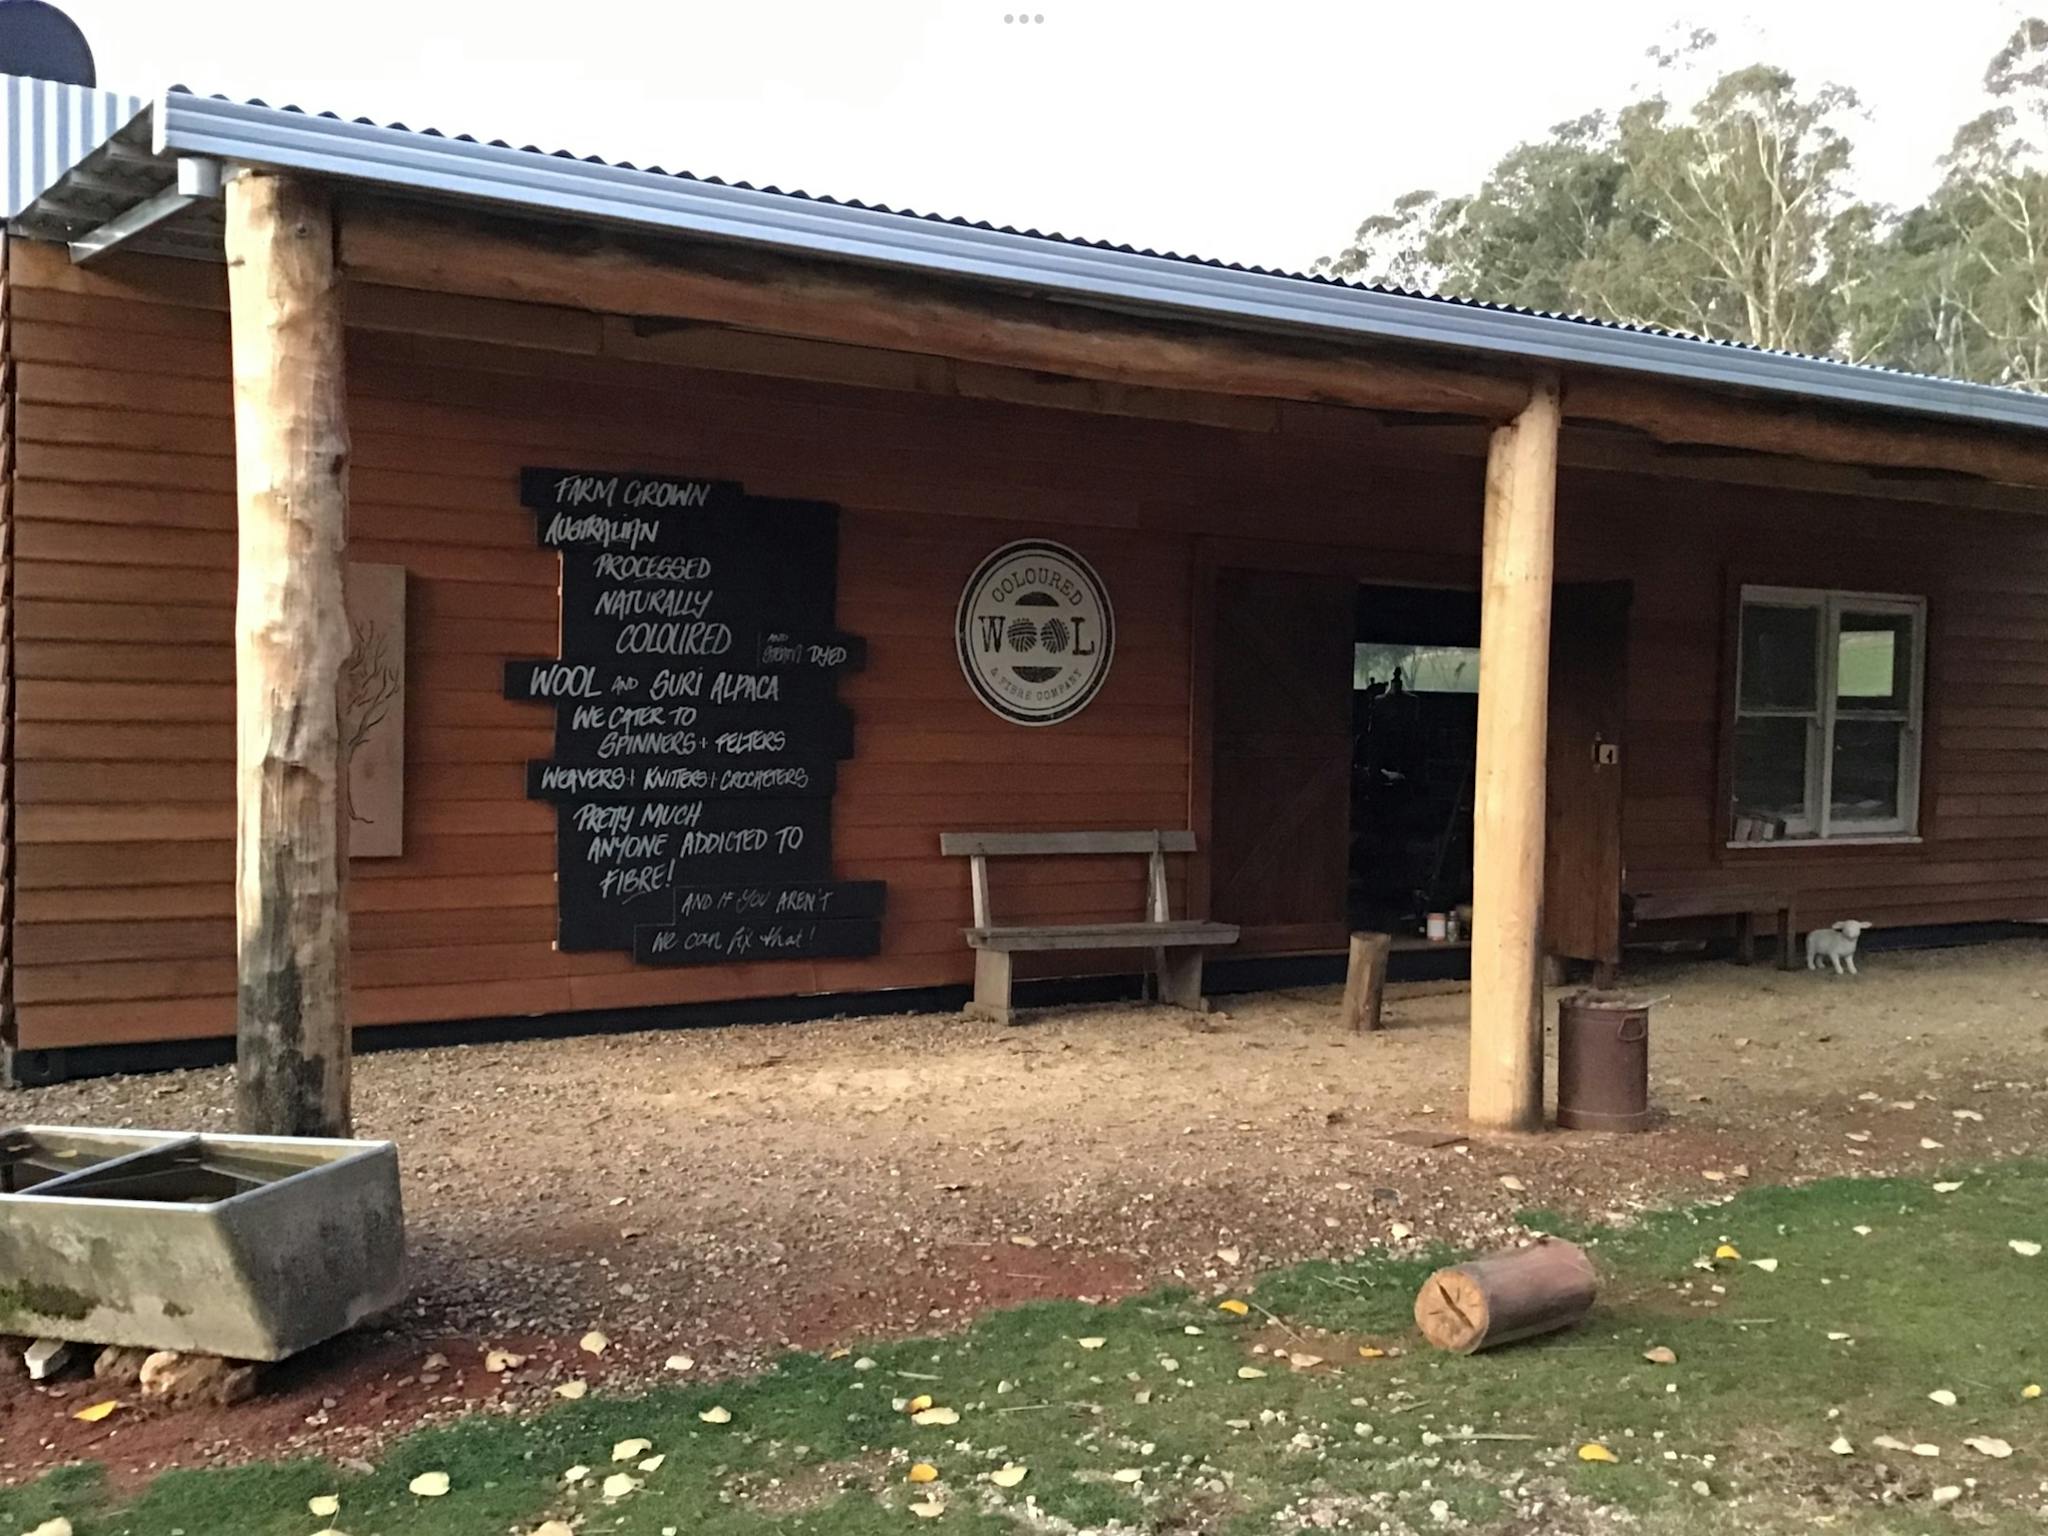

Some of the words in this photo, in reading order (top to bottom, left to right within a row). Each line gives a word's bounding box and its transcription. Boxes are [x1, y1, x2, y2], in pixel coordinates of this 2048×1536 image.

[554, 476, 618, 505] FARM
[623, 479, 711, 507] GROWN
[592, 554, 712, 581] PROCESSED
[992, 567, 1082, 606] COLOURED
[594, 589, 713, 618] NATURALLY
[616, 623, 732, 655] COLOURED
[978, 615, 1095, 656] WOOL
[807, 645, 847, 667] DYED
[529, 664, 602, 699] WOOL
[610, 677, 639, 692] AND
[710, 671, 780, 704] ALPACA
[1036, 667, 1082, 701] COMPANY
[572, 705, 605, 730] WE
[609, 705, 666, 732] CATER
[668, 707, 697, 727] TO
[597, 732, 696, 759] SPINNERS
[714, 731, 786, 753] FELTERS
[541, 767, 626, 794] WEAVERS
[642, 768, 708, 792] KNITTERS
[719, 768, 809, 791] CROCHETERS
[573, 803, 632, 833] PRETTY
[640, 801, 703, 827] MUCH
[587, 833, 668, 865] ANYONE
[680, 828, 768, 859] ADDICTED
[774, 826, 803, 854] TO
[600, 858, 676, 901] FIBRE!
[680, 892, 712, 917] AND
[717, 893, 733, 910] IF
[735, 889, 771, 914] YOU
[775, 888, 835, 914] AREN'T
[684, 931, 723, 952] can
[727, 926, 755, 956] fix
